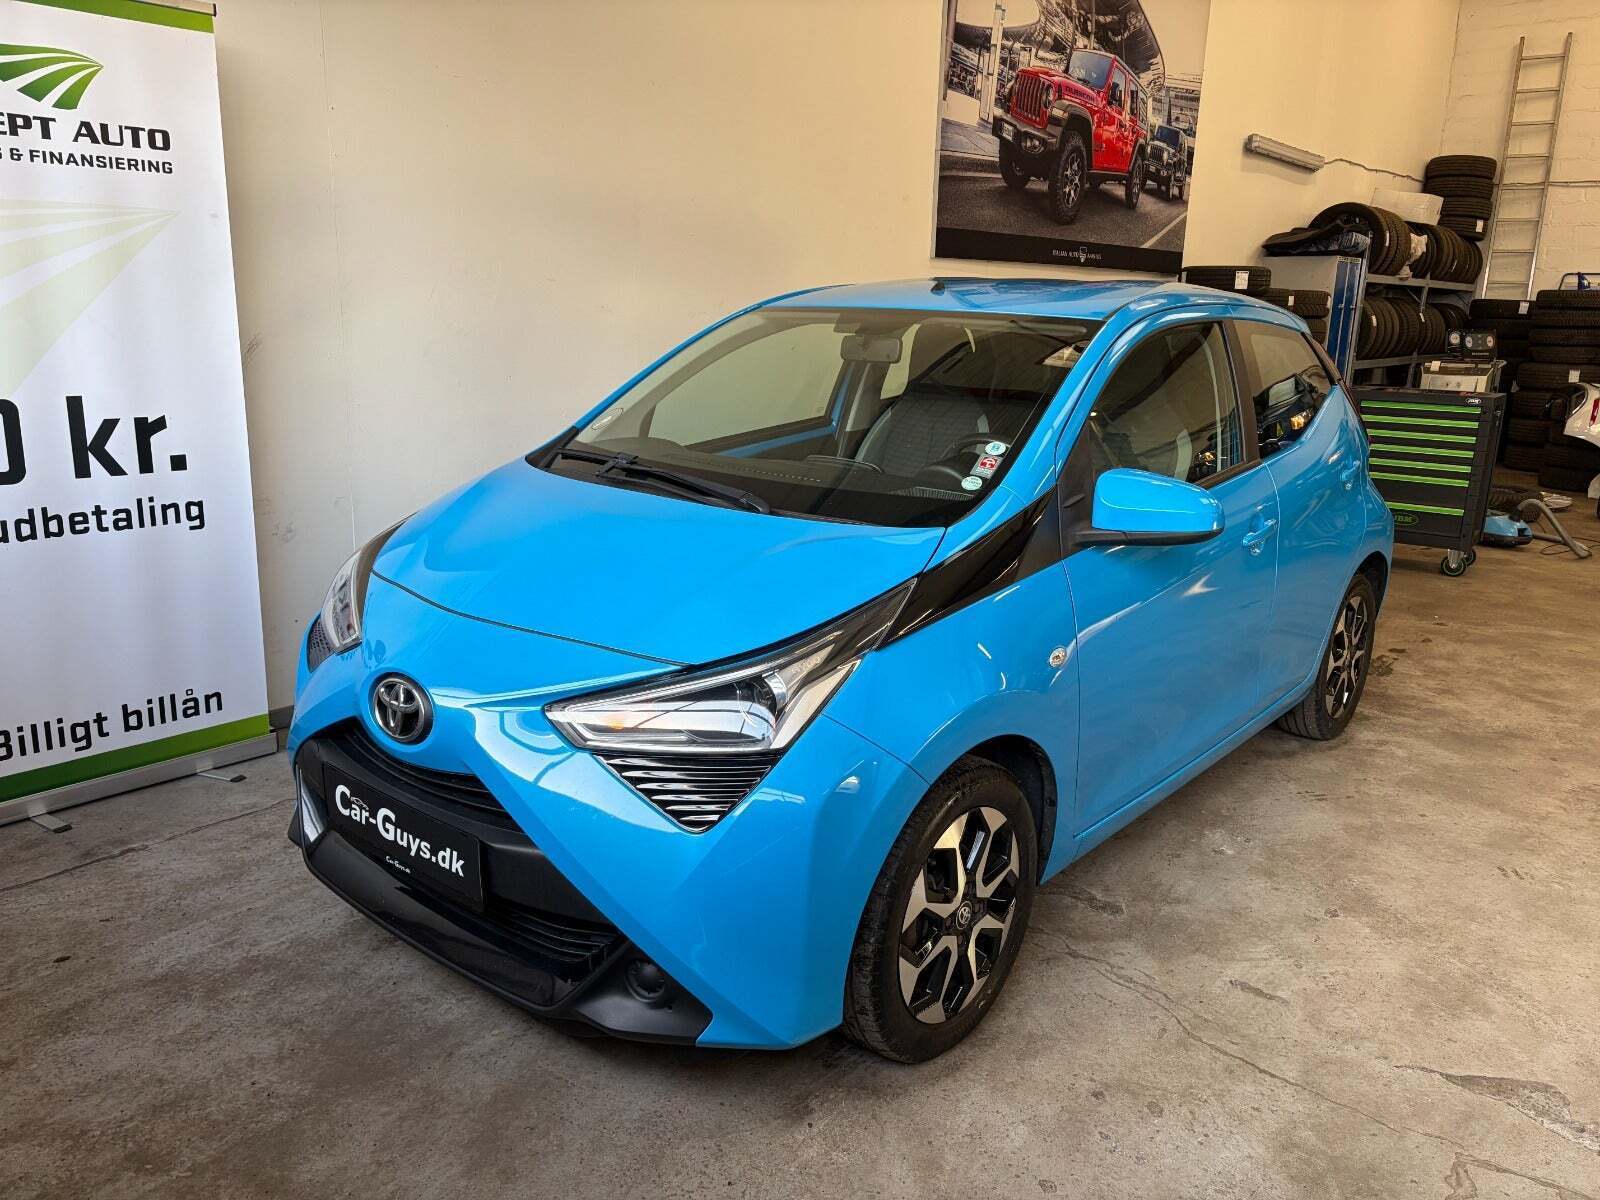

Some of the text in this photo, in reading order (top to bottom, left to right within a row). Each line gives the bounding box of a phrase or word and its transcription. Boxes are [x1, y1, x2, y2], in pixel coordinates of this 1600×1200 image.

[73, 120, 171, 152] AUTO
[9, 147, 24, 162] &
[29, 149, 174, 175] FINANSIERING
[65, 395, 187, 479] kr.
[121, 689, 223, 732] billån
[335, 785, 464, 877] Car-Guys.dk
